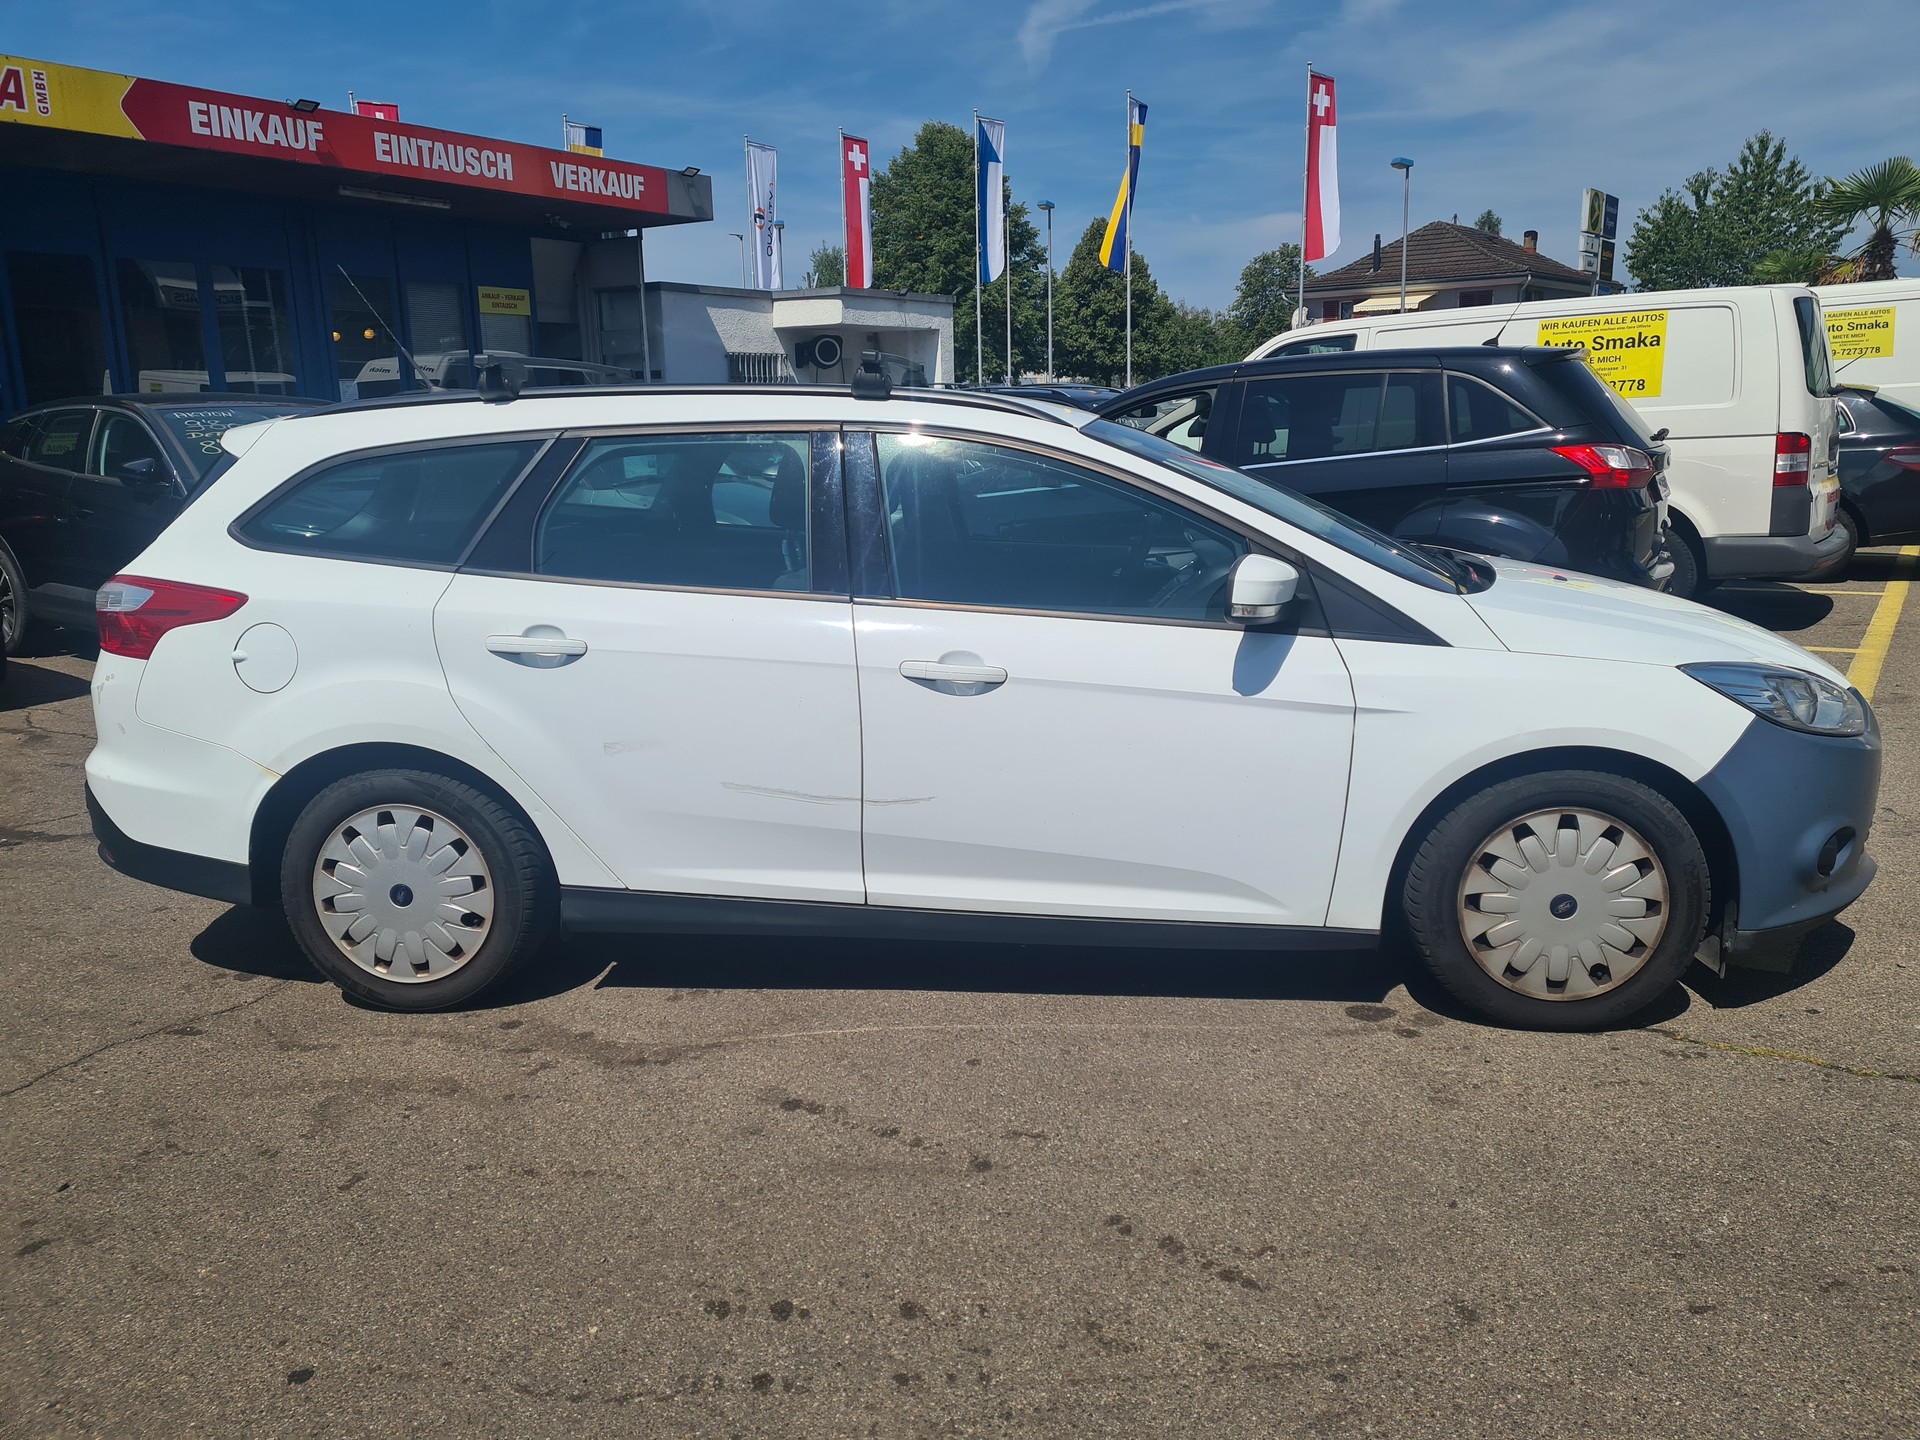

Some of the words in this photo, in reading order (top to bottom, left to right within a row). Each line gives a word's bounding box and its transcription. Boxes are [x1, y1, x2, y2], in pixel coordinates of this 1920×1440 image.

[0, 65, 28, 112] A
[32, 70, 50, 115] GMBH
[188, 100, 324, 152] EINKAUF
[373, 131, 514, 181] EINTAUSCH
[550, 160, 645, 201] VERKAUF
[481, 292, 500, 300] ANKAUF
[1541, 322, 1559, 331] WIR
[1562, 319, 1601, 329] KAUFEN
[1603, 316, 1628, 326] ALLE
[1629, 313, 1665, 323] AUTOS
[1847, 320, 1889, 331] Smaka
[1592, 331, 1661, 351] Smaka
[1832, 346, 1881, 356] 9-7273778
[1597, 355, 1621, 363] MICH
